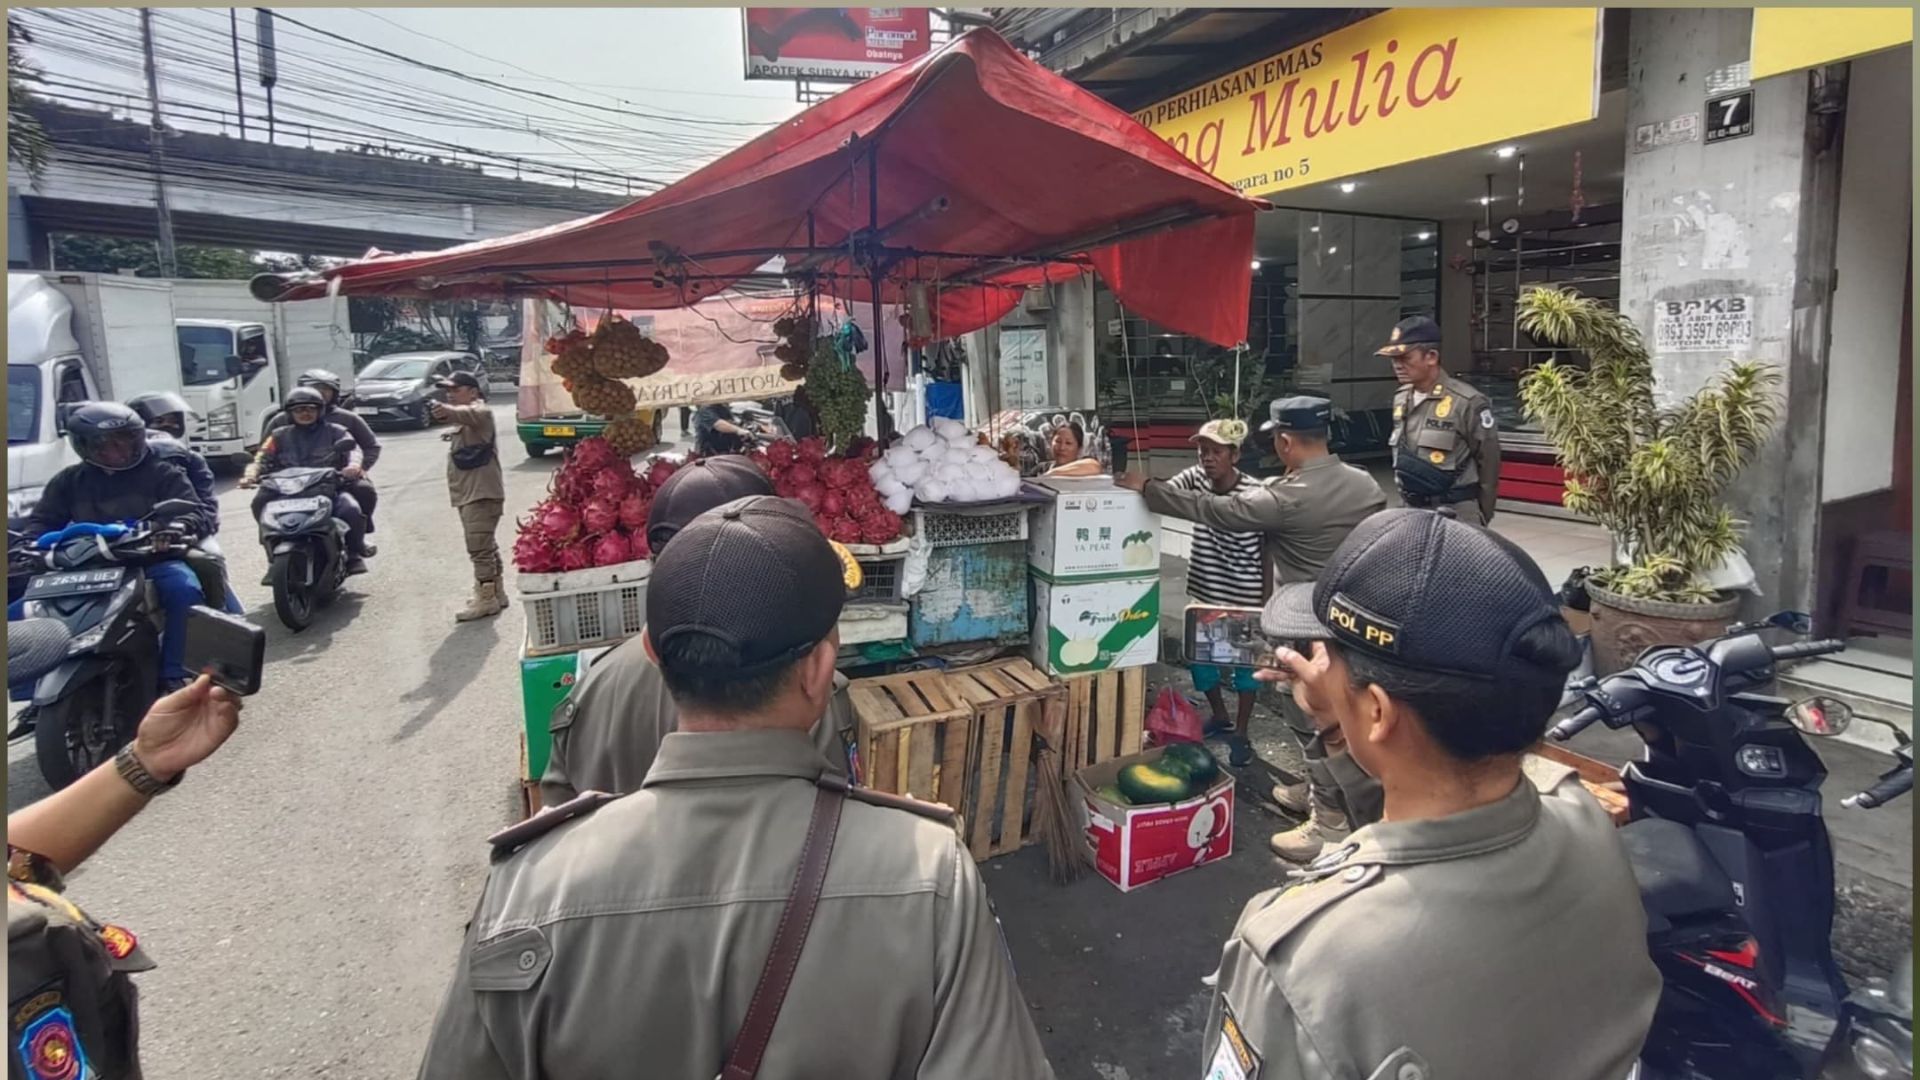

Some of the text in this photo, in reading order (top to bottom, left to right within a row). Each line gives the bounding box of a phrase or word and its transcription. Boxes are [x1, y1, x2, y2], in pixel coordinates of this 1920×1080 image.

[753, 65, 804, 76] APOTEK
[808, 67, 850, 78] SURYA
[1157, 68, 1257, 125] PERHIASAN
[1263, 42, 1323, 85] EMAS
[1166, 37, 1462, 175] ng Mulia
[1720, 97, 1741, 126] 7
[1230, 158, 1310, 194] gara no 5
[1667, 298, 1745, 315] BPKB
[1330, 606, 1394, 646] POL PP
[1134, 852, 1178, 874] APPLE
